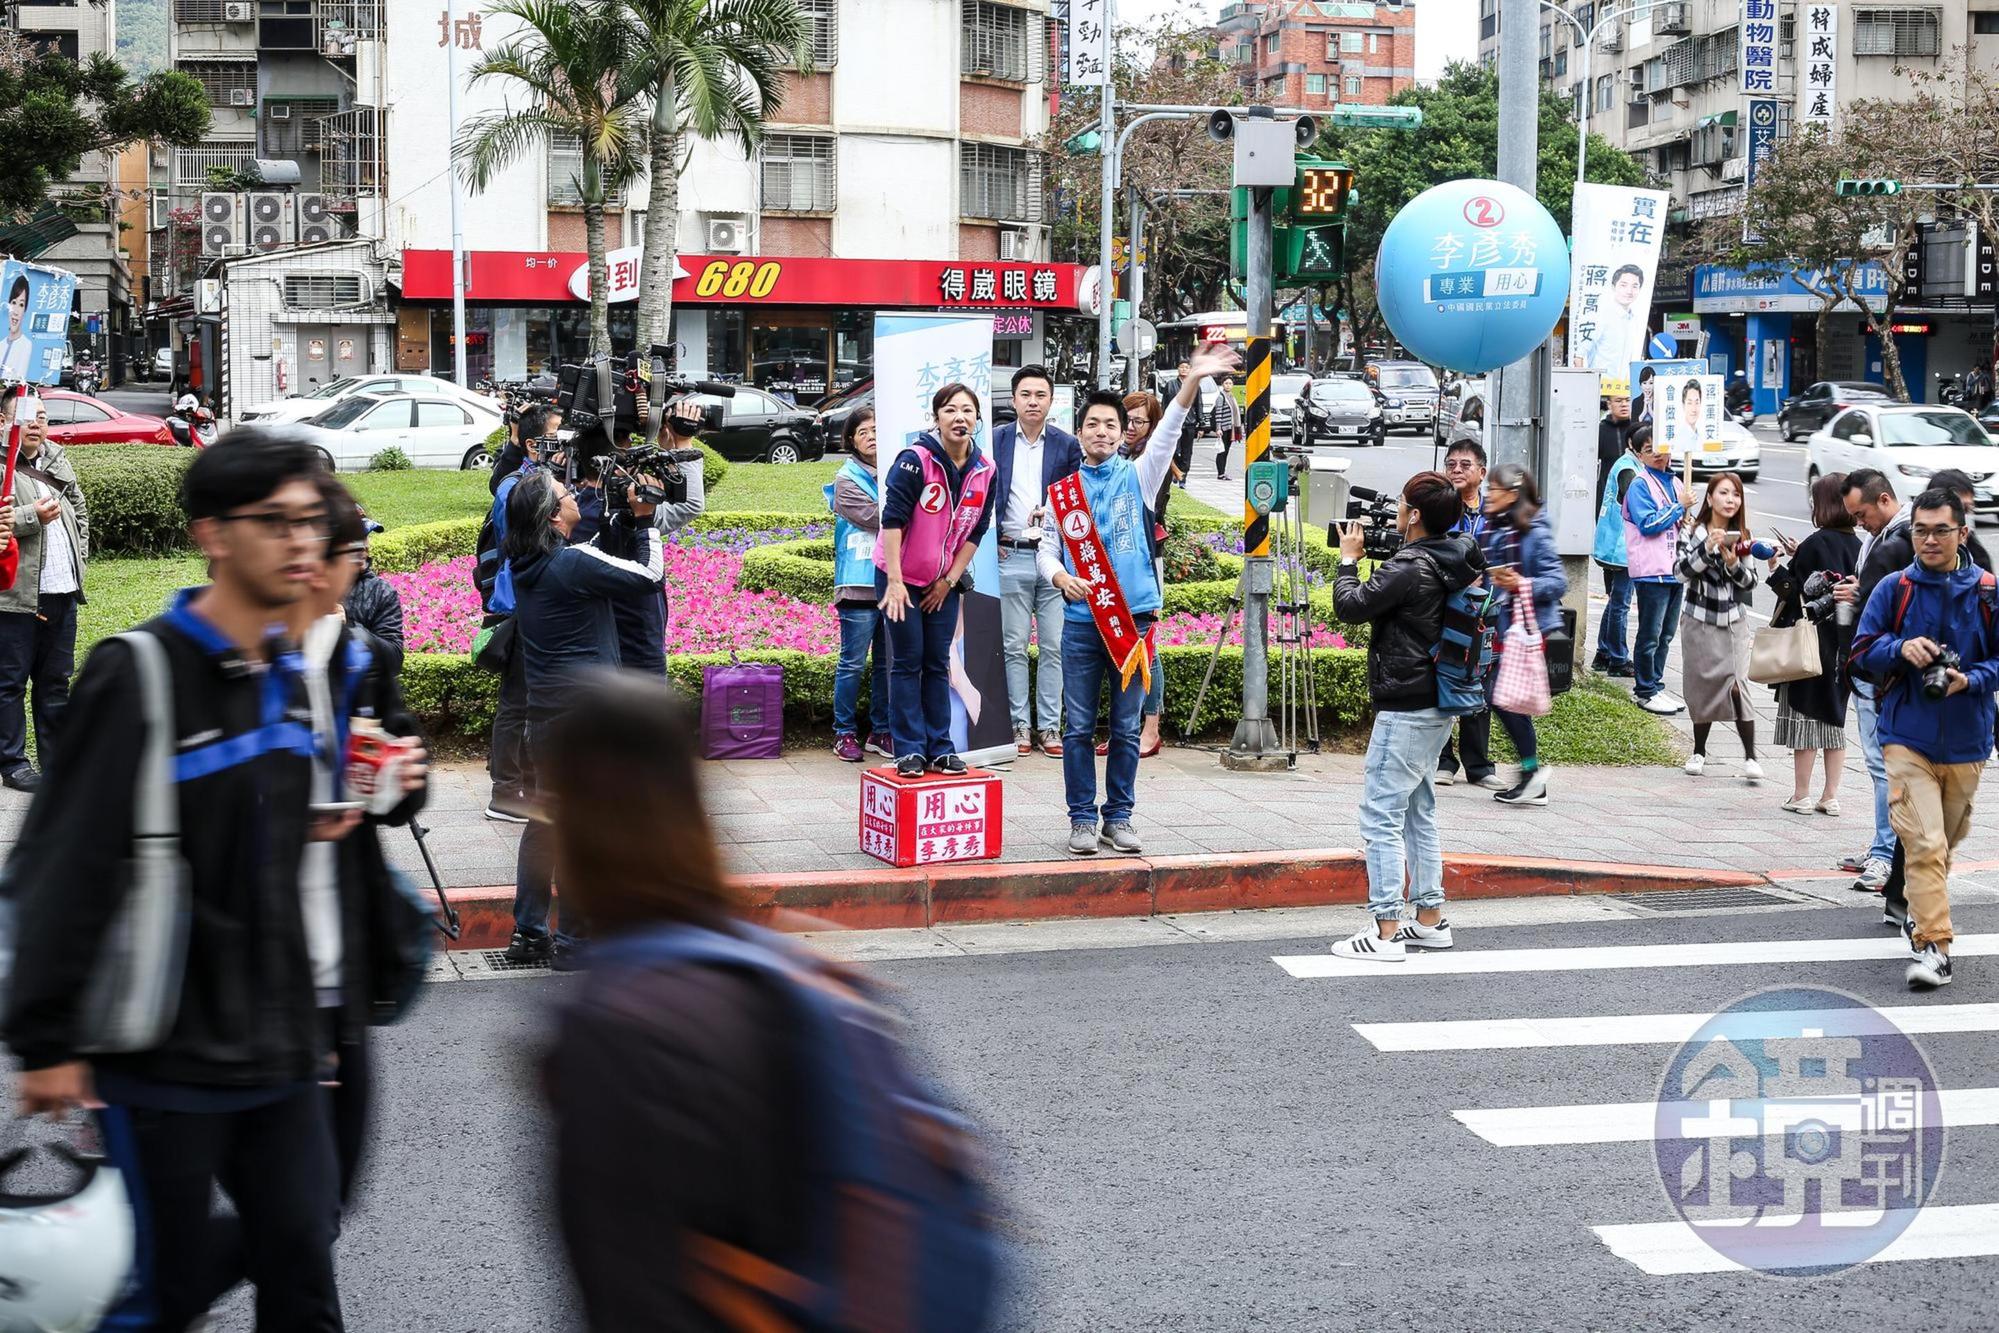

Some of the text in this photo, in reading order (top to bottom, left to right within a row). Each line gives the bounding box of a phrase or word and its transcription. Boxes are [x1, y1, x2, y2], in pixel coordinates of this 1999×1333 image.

[437, 10, 483, 50] 城
[1745, 0, 1775, 91] 動物醫院
[1808, 7, 1834, 134] 梓成婦產
[1754, 129, 1771, 175] 艾美
[1302, 171, 1338, 212] 32
[1627, 196, 1656, 244] 實在
[1430, 229, 1538, 270] 李彥秀
[695, 259, 783, 299] 680
[941, 268, 1058, 302] 得崴眼鏡
[1439, 273, 1528, 295] 專業 用心
[1579, 265, 1609, 343] 蔣萬安
[924, 485, 941, 511] 2
[1071, 514, 1085, 533] 4
[1078, 540, 1116, 610] 蔣萬安
[866, 785, 892, 817] 用心
[924, 792, 980, 820] 用心
